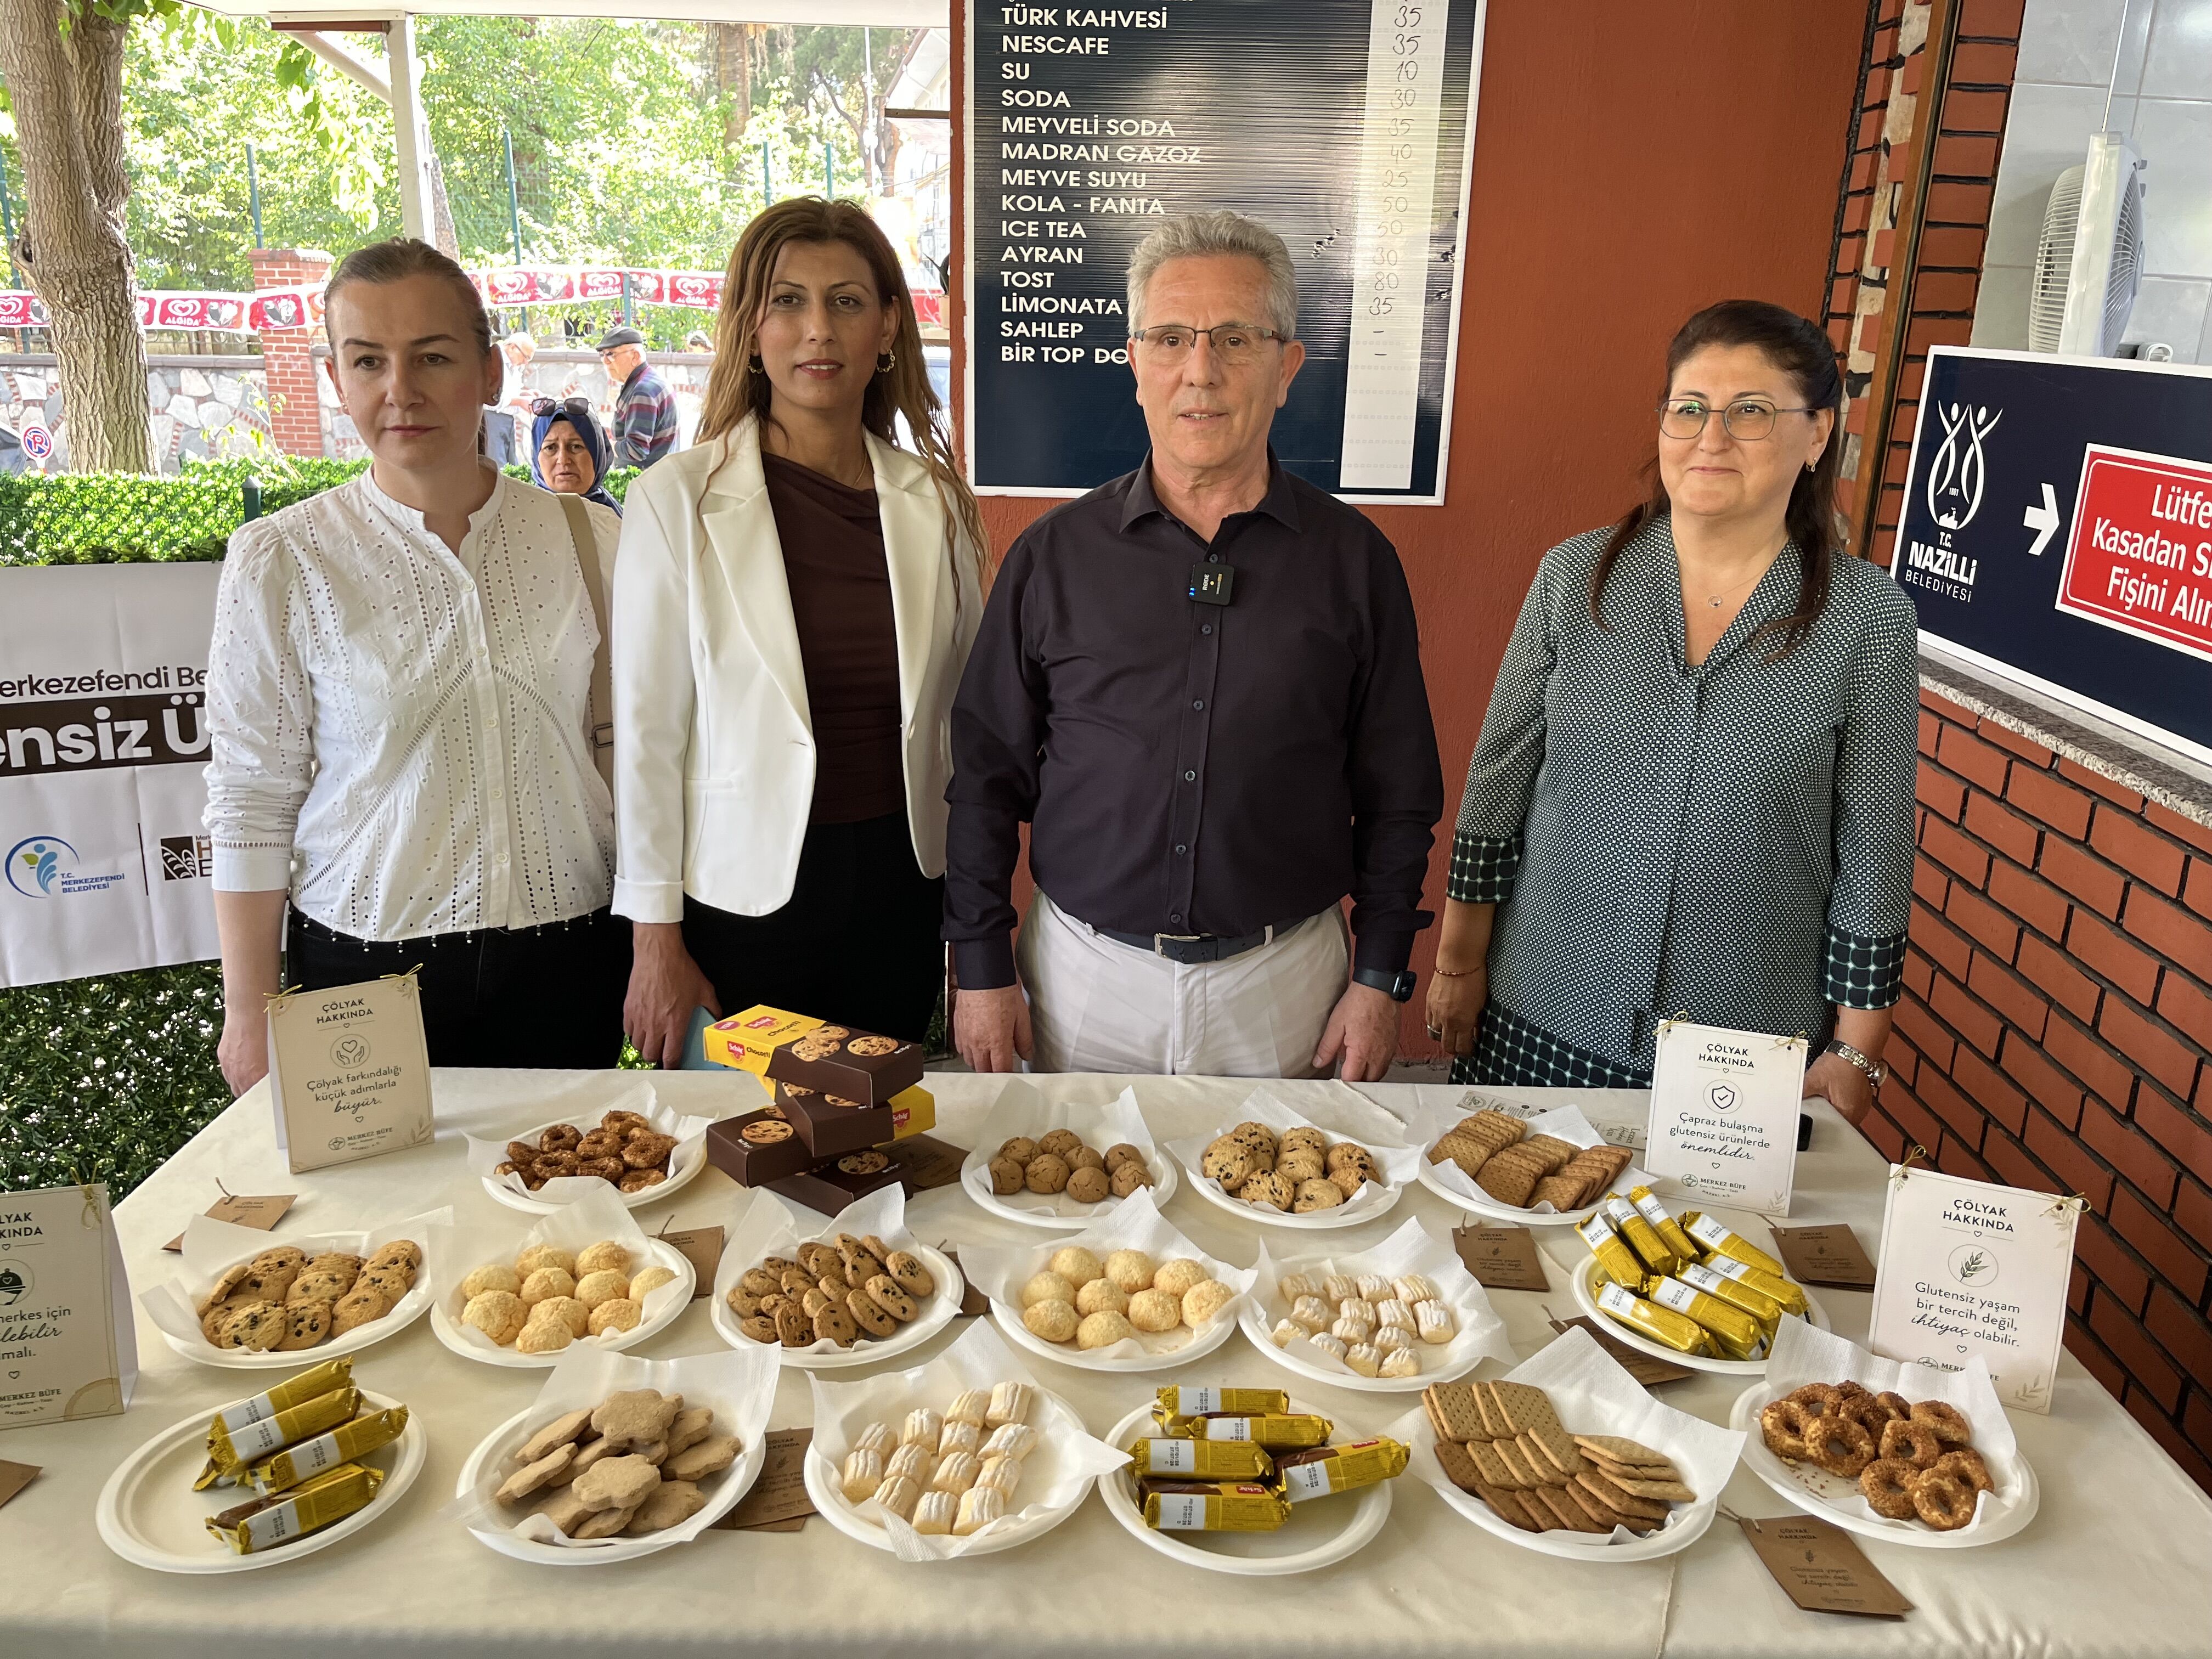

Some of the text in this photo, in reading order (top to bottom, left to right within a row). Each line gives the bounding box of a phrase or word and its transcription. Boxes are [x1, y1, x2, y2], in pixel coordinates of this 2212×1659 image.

[1002, 4, 1167, 28] TÜRK KAHVESİ
[1395, 6, 1422, 27] 35
[1002, 35, 1109, 54] NESCAFE
[1393, 33, 1421, 55] 35
[1001, 63, 1030, 80] SU
[1396, 61, 1418, 82] 10
[1001, 89, 1071, 108] SODA
[1391, 89, 1416, 109] 30
[1002, 114, 1176, 136] MEYVELİ SODA
[1389, 118, 1415, 136] 35
[1002, 142, 1201, 163] MADRAN GAZOZ
[1391, 144, 1412, 164] 40
[1002, 169, 1147, 188] MEYVE SUYU
[1382, 170, 1412, 187] 25
[1002, 194, 1066, 212] KOLA
[1090, 196, 1166, 215] FANTA
[1383, 196, 1408, 212] 50
[1002, 221, 1087, 238] ICE TEA
[1377, 220, 1402, 238] 50
[1001, 246, 1083, 263] AYRAN
[1373, 247, 1397, 266] 30
[1001, 272, 1054, 288] TOST
[1374, 271, 1398, 290] 80
[497, 292, 528, 303] ALGIDA
[587, 286, 620, 297] ALGIDA
[1001, 292, 1123, 314] LİMONATA
[1369, 297, 1395, 315] 35
[165, 316, 199, 326] ALGIDA
[1001, 321, 1084, 338] SAHLEP
[1002, 342, 1128, 364] BİR TOP DO
[1939, 532, 1951, 548] T.C.
[2091, 517, 2186, 571] Kasadan
[1908, 540, 1977, 585] NAZİLLİ
[1905, 569, 1972, 602] BELEDİYESİ
[2107, 566, 2168, 611] Fişini
[0, 666, 169, 697] erkezefendi
[162, 693, 212, 755] Ü
[61, 873, 125, 886] MERKEZEFENDİ
[63, 882, 109, 893] BELEDİYESİ
[322, 998, 365, 1013] ÇÖLYAK
[316, 1008, 374, 1024] HAKKINDA
[1707, 1043, 1749, 1056] ÇÖLYAK
[1699, 1053, 1754, 1068] HAKKINDA
[306, 1065, 402, 1092] Çölyak farkındalığı
[315, 1079, 397, 1102] küçük adımlarla
[1679, 1112, 1763, 1134] Çapraz bulaşma
[1670, 1126, 1770, 1148] glutensiz ürünlerde
[1680, 1141, 1756, 1161] önemlidir.
[1700, 1178, 1727, 1187] MERKEZ
[1953, 1199, 2007, 1217] ÇÖLYAK
[1942, 1211, 2014, 1233] HAKKINDA
[1915, 1282, 2020, 1313] Glutensiz yaşam
[47, 1305, 71, 1321] için
[1916, 1298, 2018, 1331] bir tercih değil,
[1911, 1313, 2019, 1347] ihtiyaç olabilir.
[0, 1389, 62, 1402] MERKEZ BÜFE
